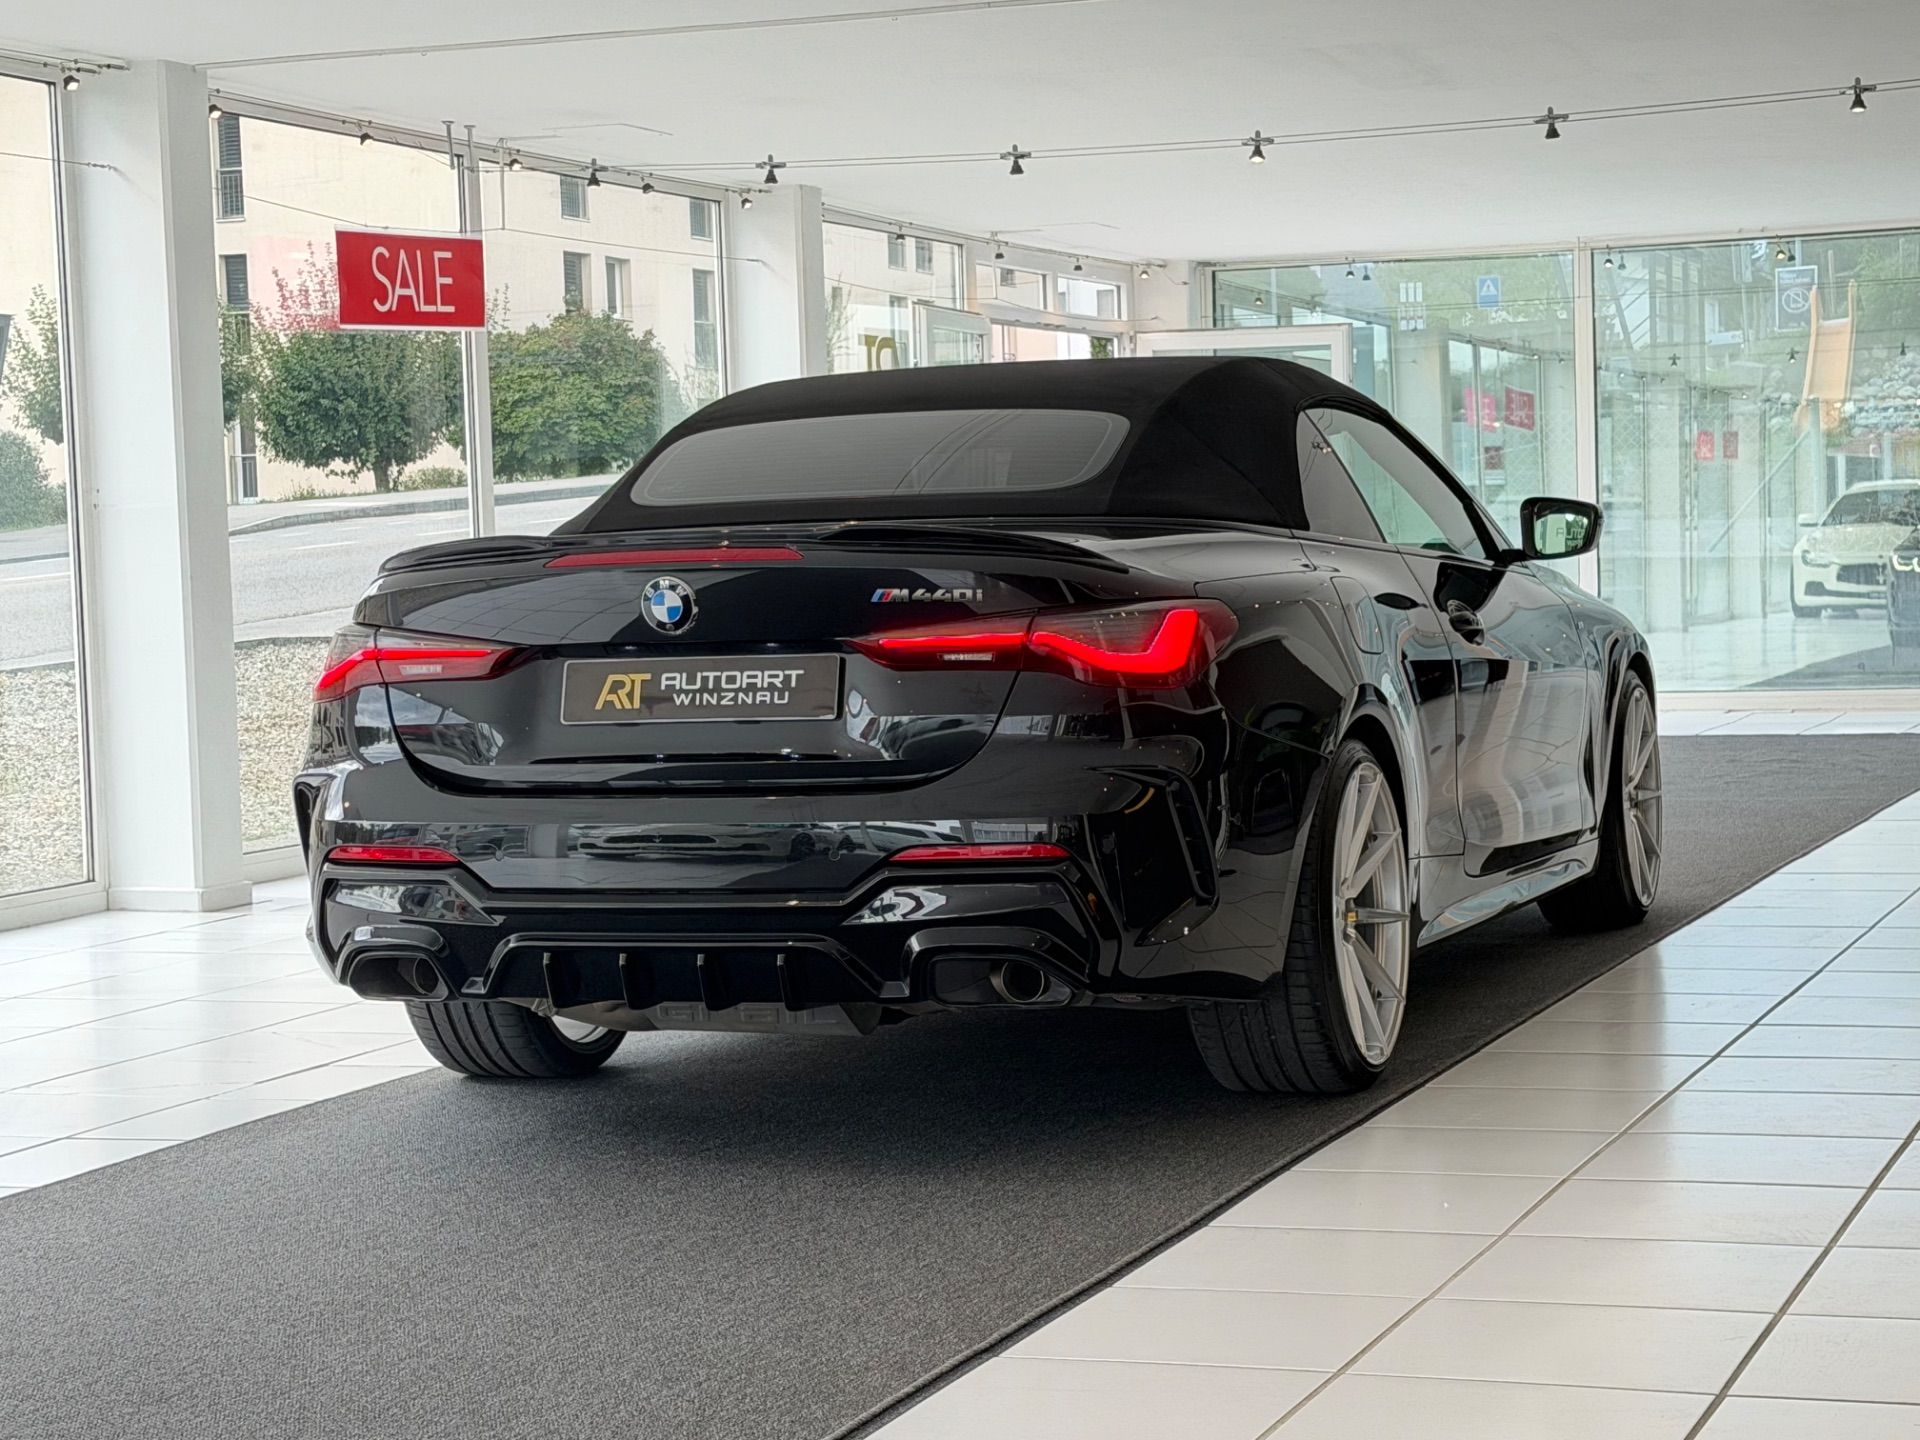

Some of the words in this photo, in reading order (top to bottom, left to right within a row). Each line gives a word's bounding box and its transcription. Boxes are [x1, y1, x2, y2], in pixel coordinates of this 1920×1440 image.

[371, 246, 456, 313] SALE
[645, 579, 689, 598] BMW
[870, 588, 983, 602] M440i
[660, 669, 805, 691] AUTOART
[672, 691, 789, 706] WINZNAU
